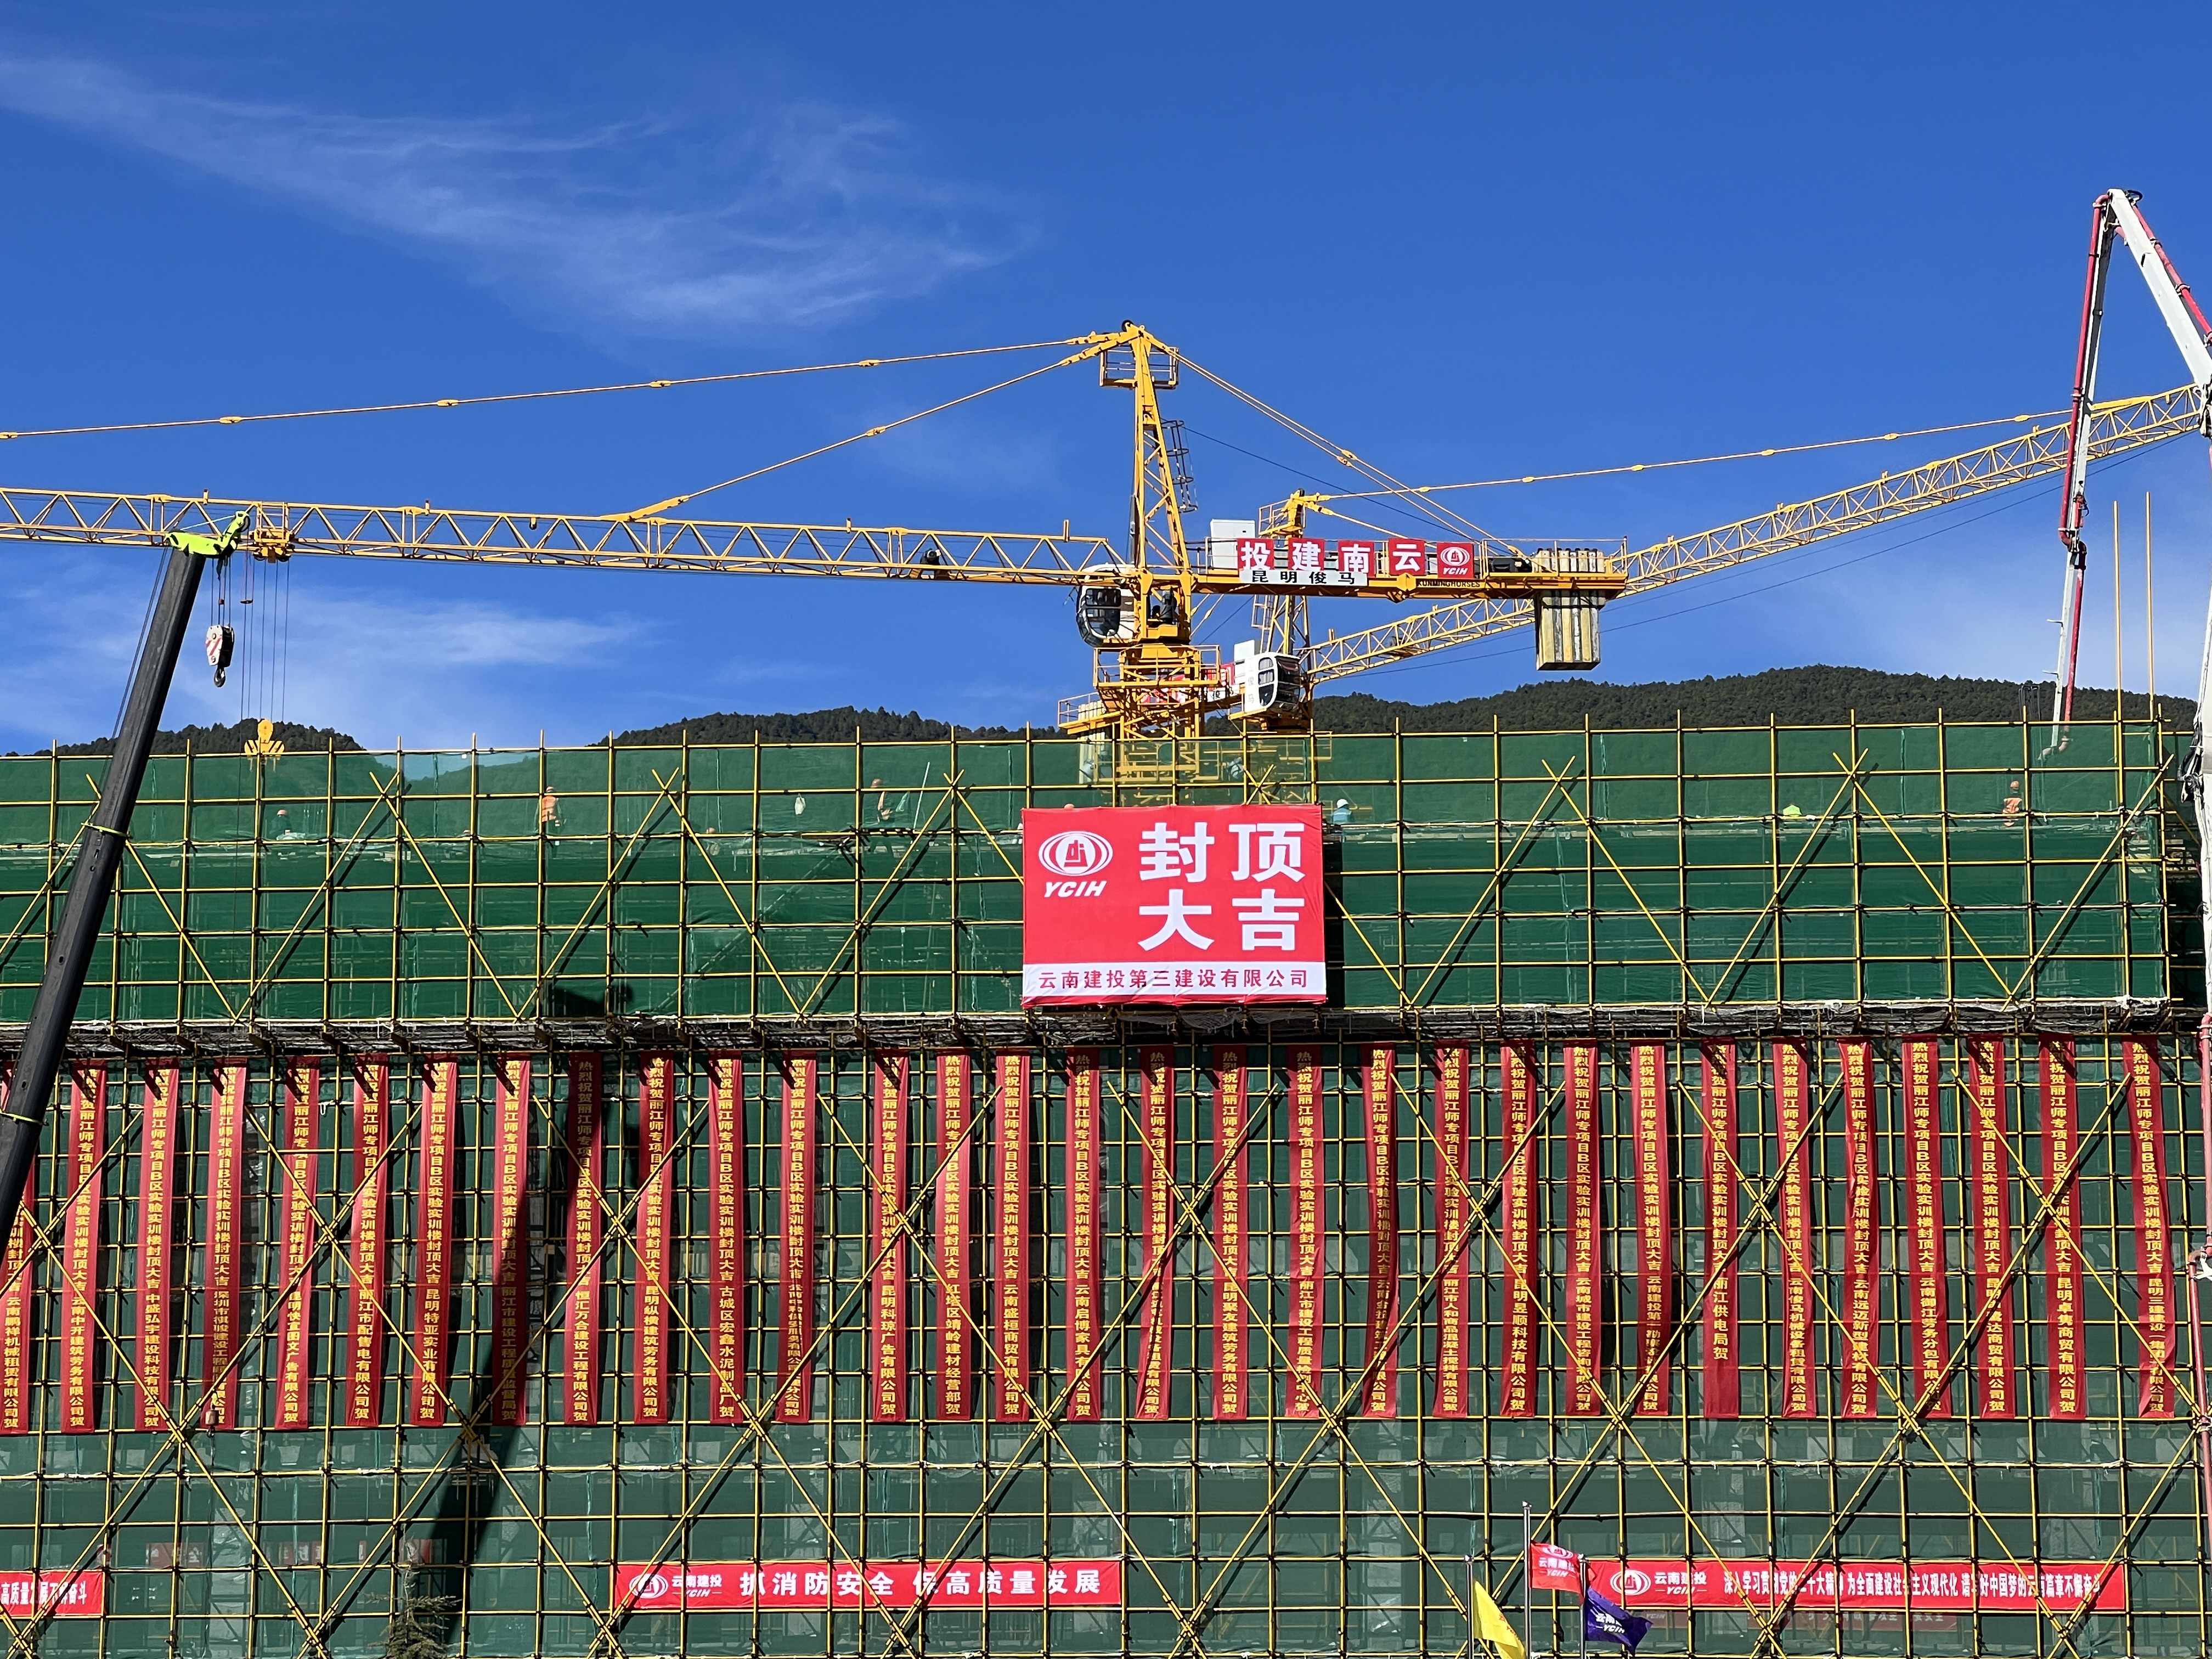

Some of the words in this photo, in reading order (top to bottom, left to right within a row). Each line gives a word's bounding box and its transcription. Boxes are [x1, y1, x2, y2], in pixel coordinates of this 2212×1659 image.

[1251, 570, 1356, 584] 昆明俊马
[1442, 567, 1468, 575] YCIH
[1043, 880, 1107, 898] YCIH
[1138, 822, 1306, 883] 封顶
[1039, 968, 1308, 989] 云南建投第三建设有限公司
[1137, 888, 1305, 952] 大吉
[215, 1067, 236, 1285] 热烈祝贺丽江师专项目B区实验实训楼封顶大吉
[426, 1062, 448, 1284] 热烈祝贺丽江师专项目B区实验实训楼封顶大吉
[502, 1061, 520, 1282] 热烈祝贺丽江师专项目B区实验实训楼封顶大吉
[718, 1059, 735, 1280] 热烈祝贺丽江师专项目B区实验实训楼封顶大吉
[789, 1059, 806, 1279] 热烈祝贺丽江师专项目B区实验实训楼封顶大吉
[1004, 1056, 1020, 1279] 热烈祝贺丽江师专项目B区实验实训楼封顶大吉
[1075, 1054, 1090, 1279] 热烈祝贺丽江师专项目B区实验实训楼封顶大吉
[1222, 1052, 1238, 1277] 热烈祝贺丽江师专项目B区实验实训楼封顶大吉
[1297, 1052, 1314, 1276] 热烈祝贺丽江师专项目B区实验实训楼封顶大吉
[1371, 1049, 1390, 1274] 热烈祝贺丽江师专项目B区实验实训楼封顶大吉
[1573, 1047, 1590, 1272] 热烈祝贺丽江师专项目B区实验实训楼封顶大吉
[1639, 1046, 1661, 1271] 热烈祝贺丽江师专项目B区实验实训楼封顶大吉
[1847, 1045, 1869, 1274] 热烈祝贺丽江师专项目B区实验实训楼封顶大吉
[1913, 1043, 1935, 1272] 热烈祝贺丽江师专项目B区实验实训楼封顶大吉
[2132, 1043, 2163, 1273] 热烈祝贺丽江师专项目B区实验实训楼封顶大吉
[355, 1289, 374, 1419] 丽江市配售电有限公司贺
[573, 1291, 590, 1421] 恒汇万合建设工程有限公司贺
[643, 1285, 659, 1417] 昆明纵横建筑劳务有限公司贺
[719, 1286, 735, 1418] 古城区宏鑫水泥制品厂贺
[1222, 1283, 1238, 1413] 昆明聚友建筑劳务有限公司贺
[1713, 1278, 1728, 1359] 丽江供电局贺
[672, 1573, 723, 1588] 云南建投
[739, 1571, 894, 1597] 抓消防安全
[1547, 1568, 1568, 1577] YCIH
[1654, 1571, 1707, 1585] 云南建投
